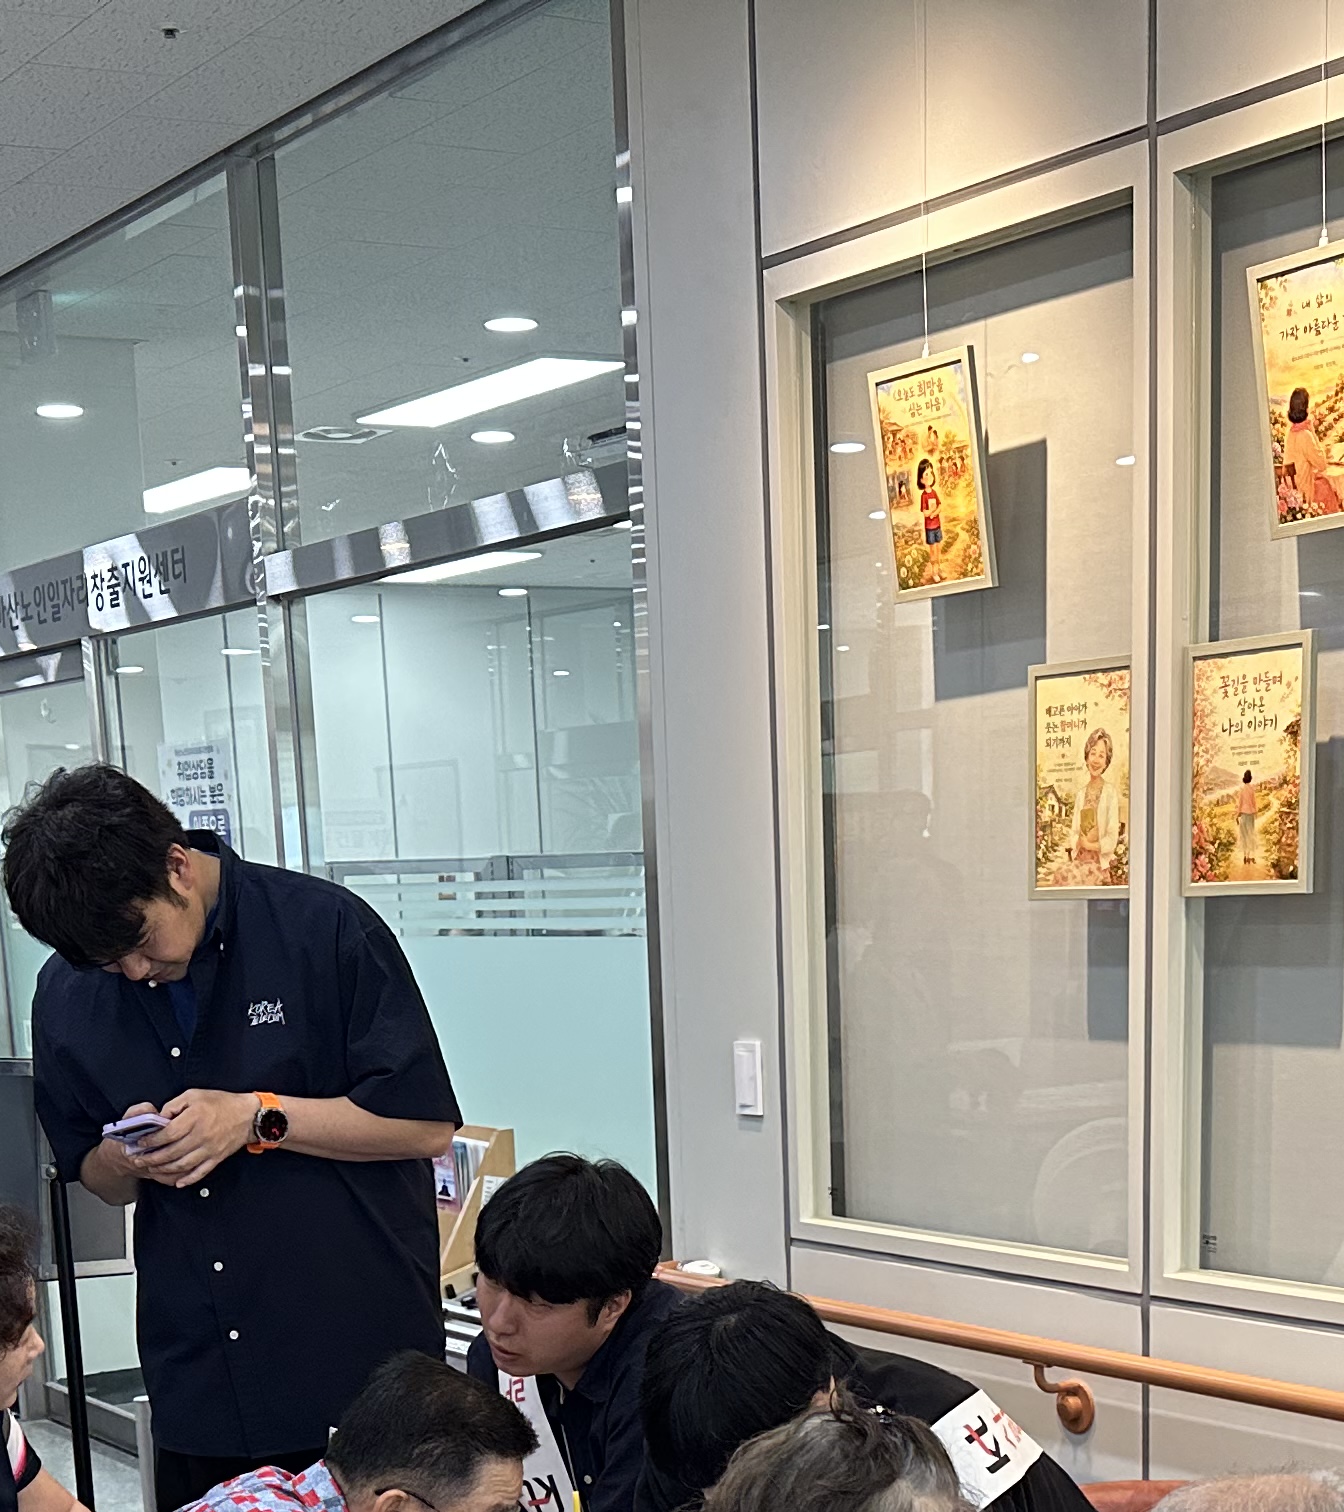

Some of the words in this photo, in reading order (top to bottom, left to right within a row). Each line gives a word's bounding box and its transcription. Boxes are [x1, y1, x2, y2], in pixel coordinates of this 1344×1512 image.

[1301, 300, 1311, 310] 내
[1279, 324, 1300, 341] 가장
[1303, 313, 1340, 336] 아름다운
[917, 377, 944, 398] 희망을
[908, 402, 923, 419] 심는
[1218, 673, 1249, 700] 꽃길을
[1252, 670, 1283, 693] 만들며
[1045, 705, 1065, 718] 배고픈
[1067, 702, 1088, 716] 아이가
[1237, 695, 1265, 717] 살아온
[1221, 717, 1243, 737] 나의
[1247, 713, 1278, 732] 이야기
[1045, 735, 1072, 749] 되기까지
[177, 757, 214, 781] 취업상담을
[170, 785, 207, 807] 희망하시는
[208, 783, 224, 804] 분은
[962, 1414, 1012, 1474] kt
